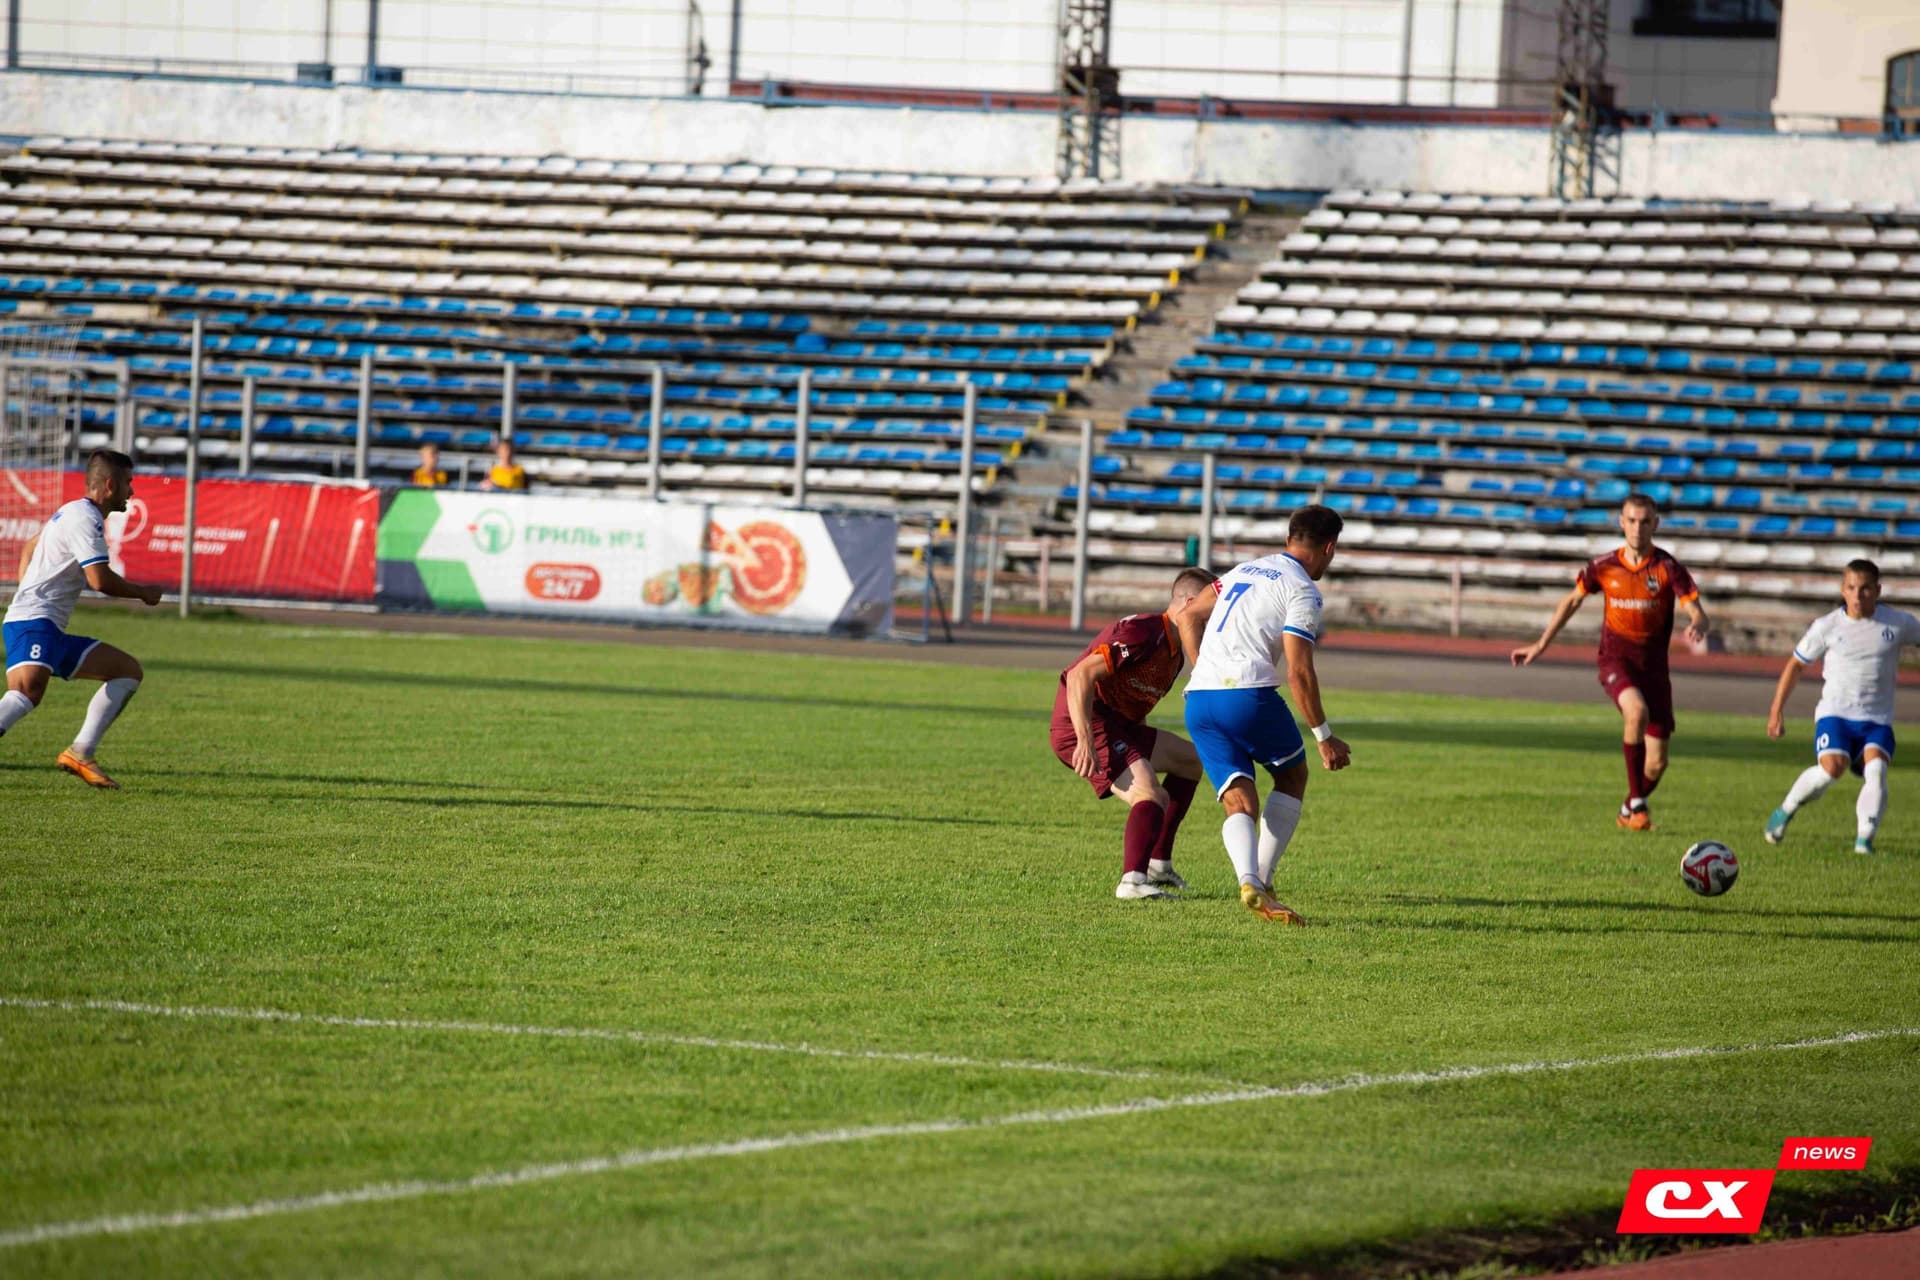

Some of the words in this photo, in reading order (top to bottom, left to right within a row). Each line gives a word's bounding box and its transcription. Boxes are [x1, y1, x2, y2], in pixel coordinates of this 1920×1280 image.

[524, 525, 601, 545] ГРИЛЬ
[543, 579, 586, 600] 24/7
[1216, 582, 1253, 633] 7
[29, 643, 42, 660] 8
